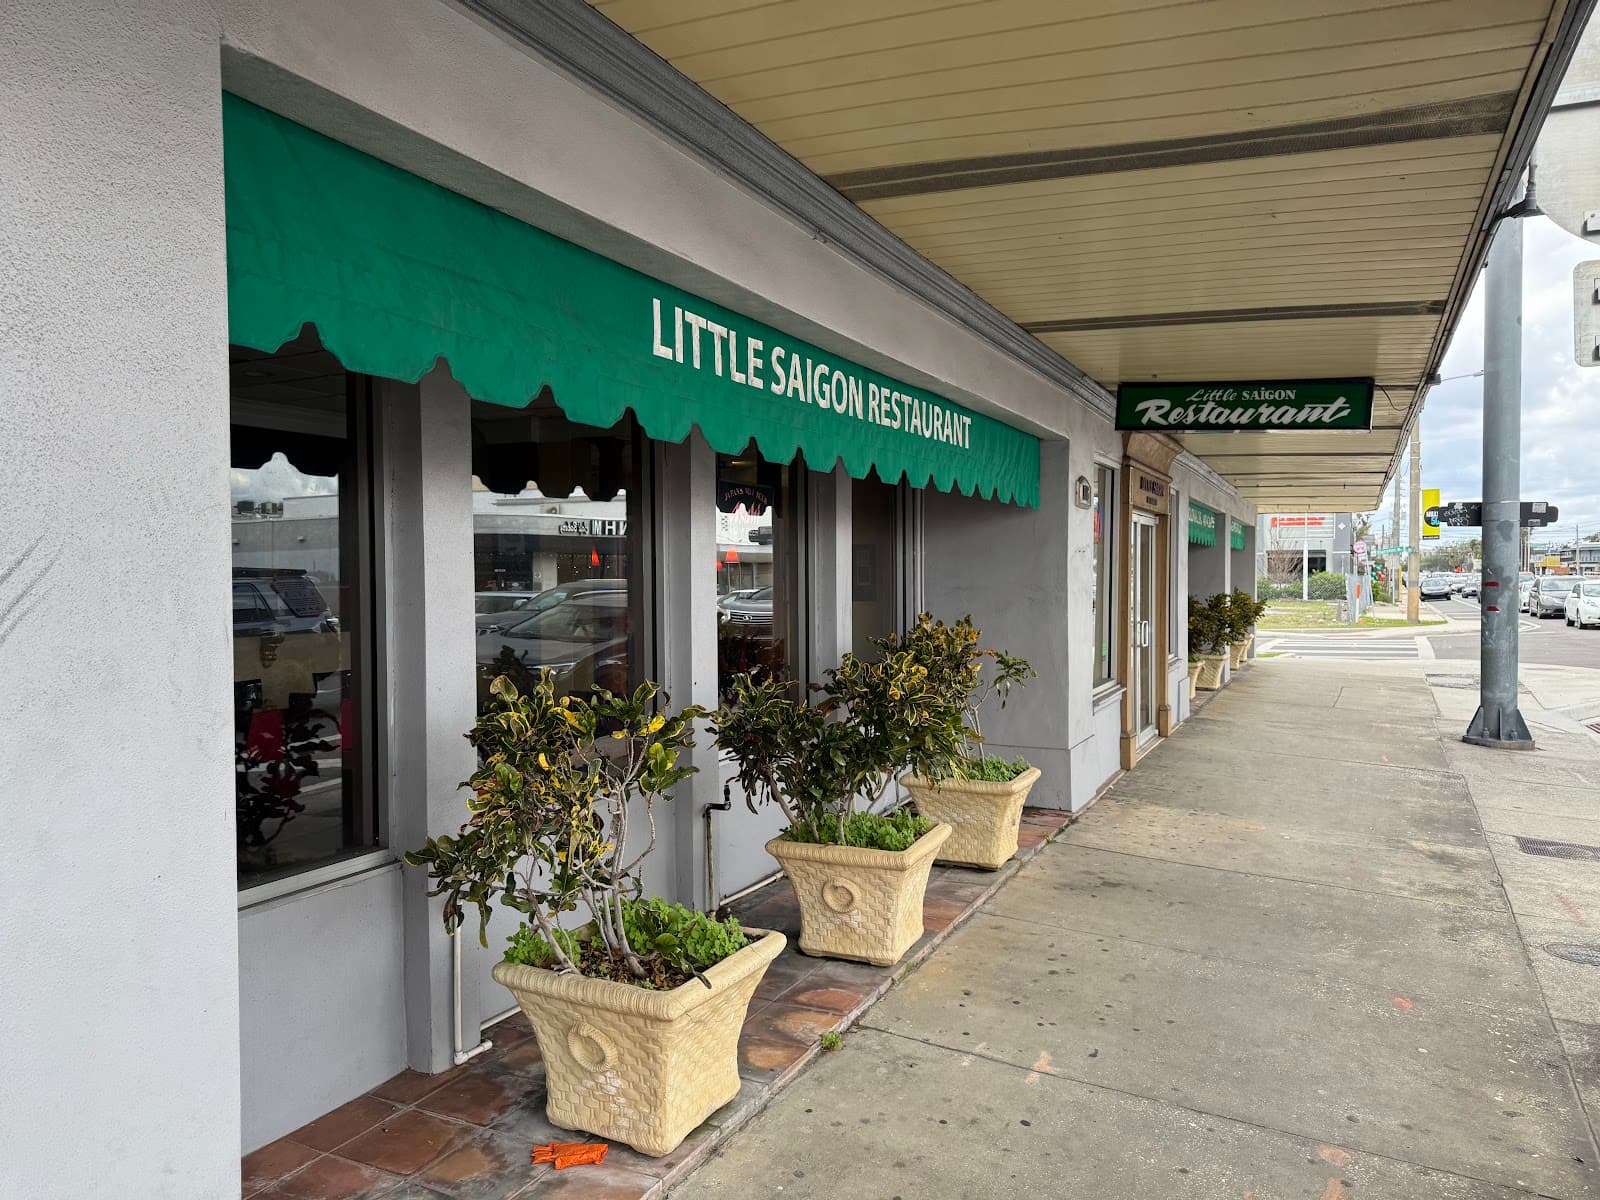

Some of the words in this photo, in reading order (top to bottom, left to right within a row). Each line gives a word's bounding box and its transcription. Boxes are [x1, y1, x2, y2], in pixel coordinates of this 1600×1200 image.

[652, 297, 763, 390] LITTLE
[770, 346, 864, 420] SAIGON
[868, 382, 972, 449] RESTAURANT
[1185, 389, 1238, 402] Little
[1134, 396, 1352, 426] Restaurant
